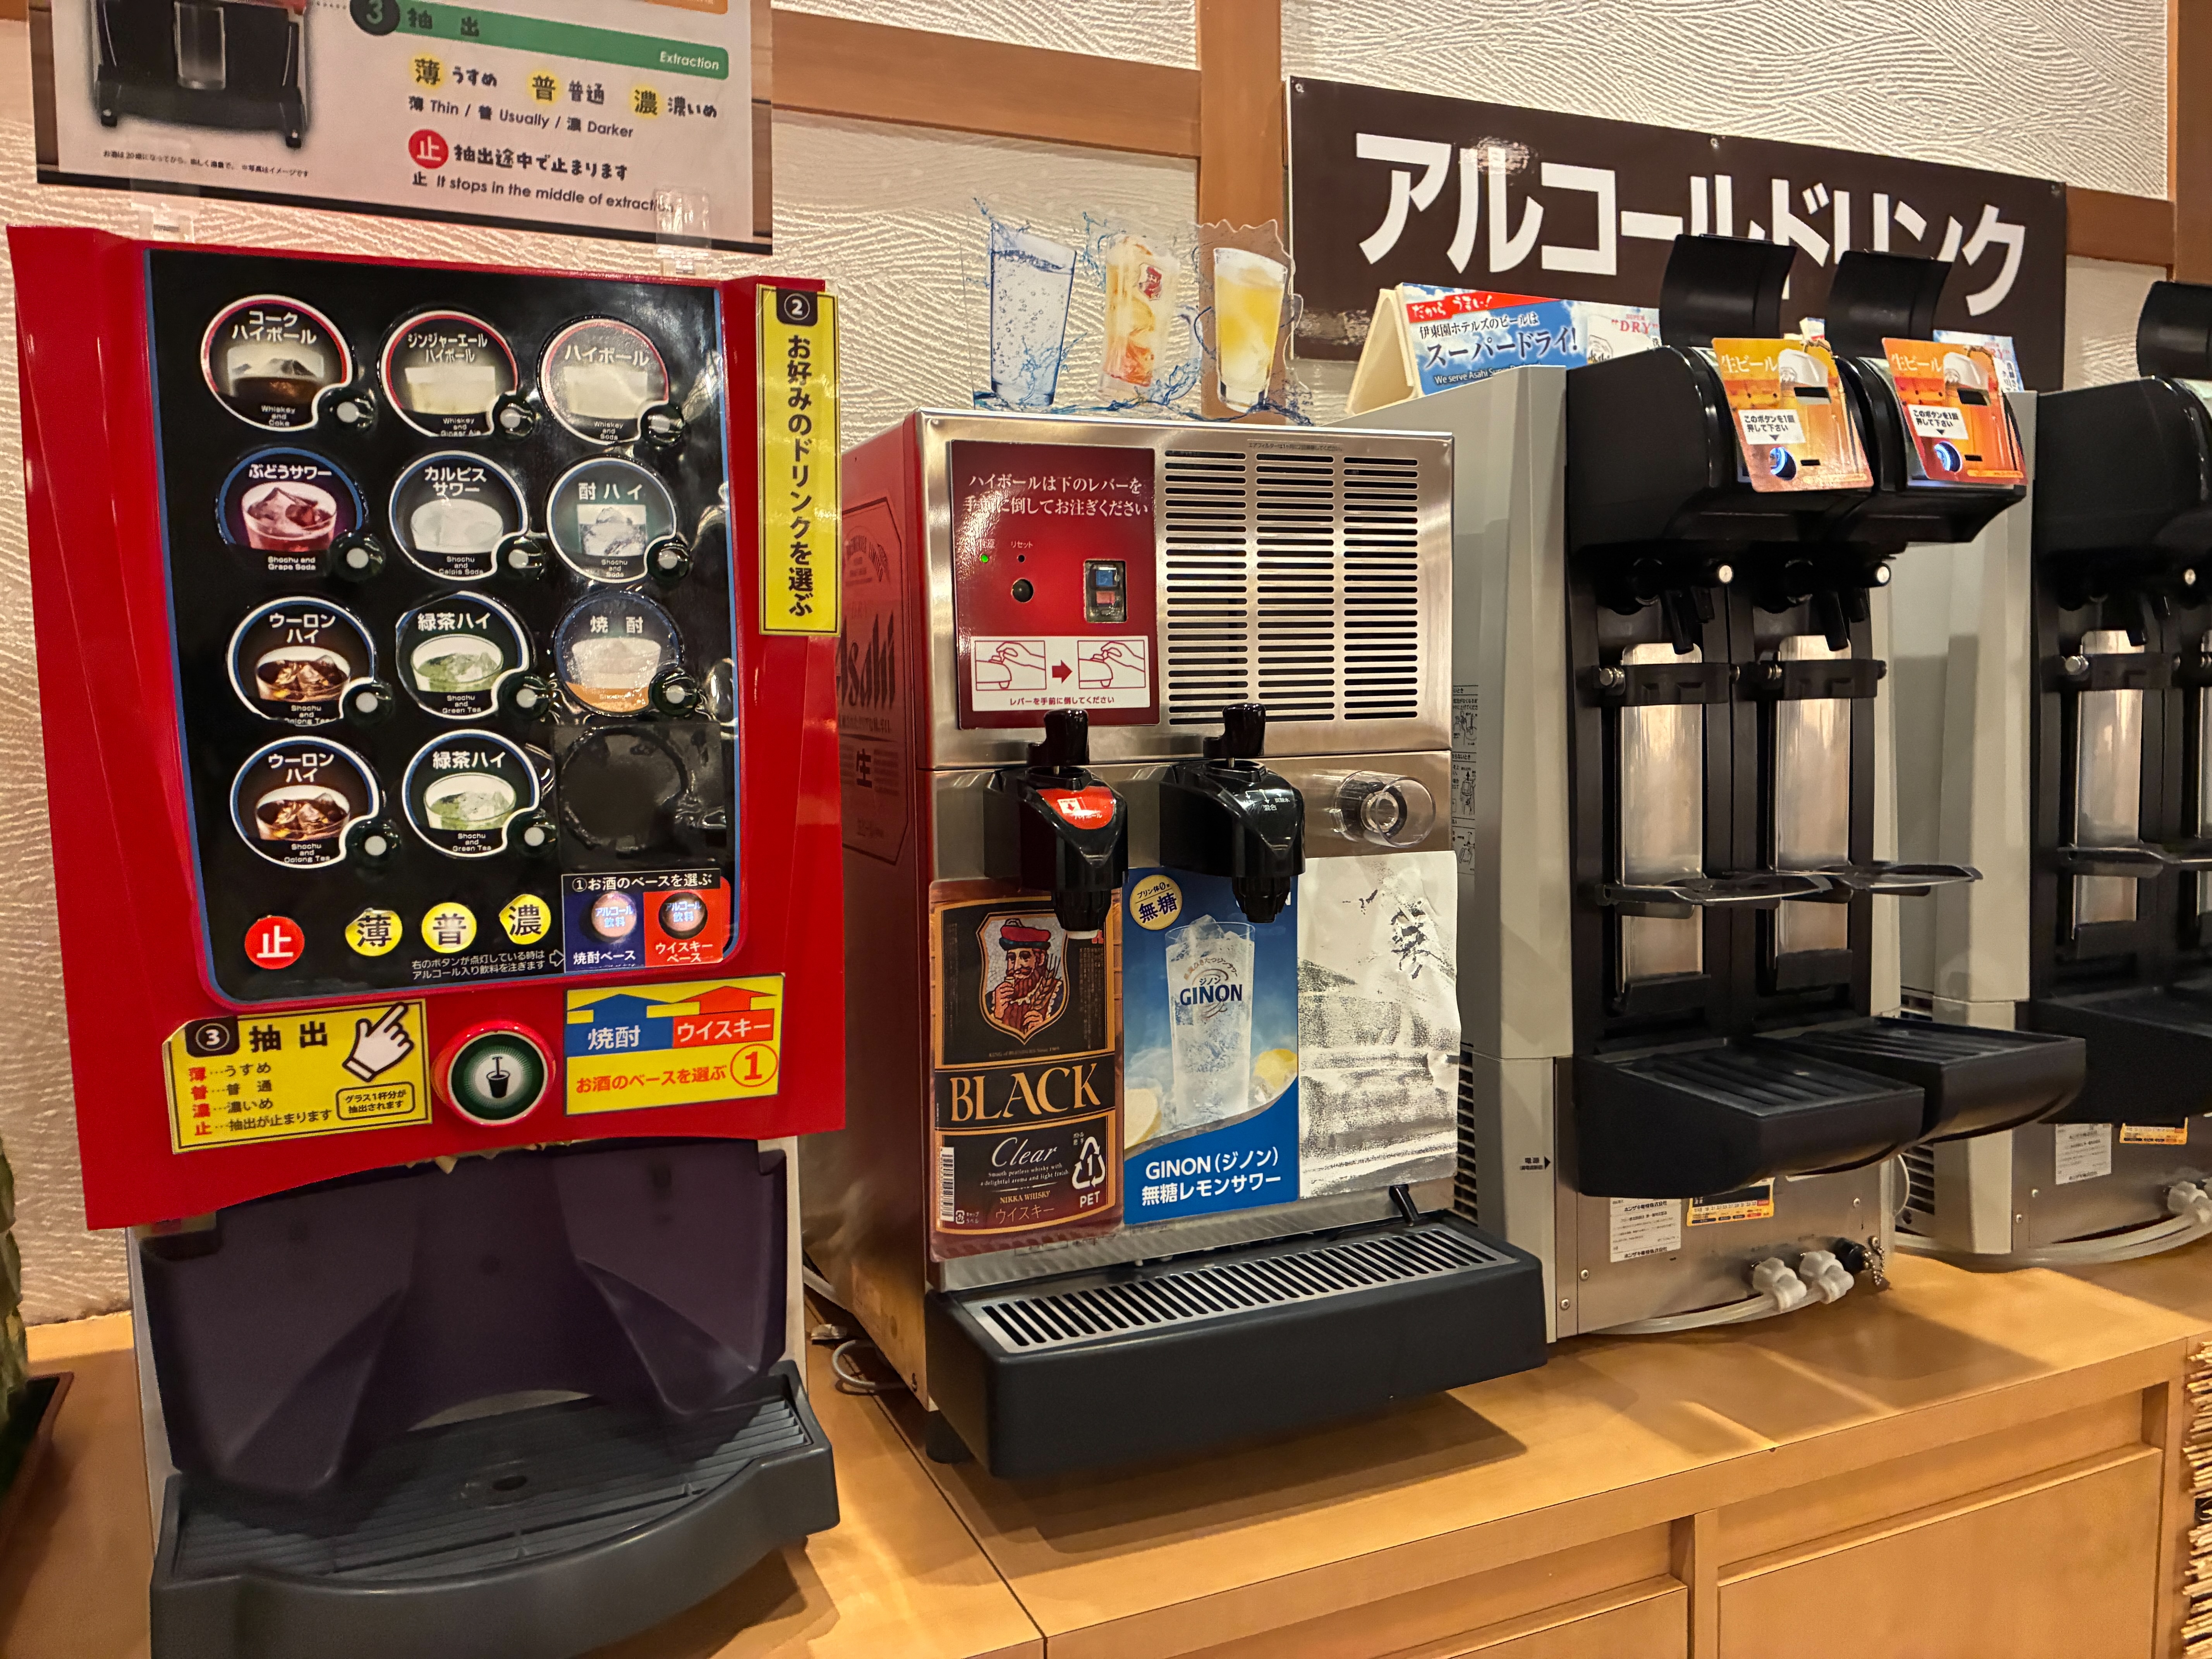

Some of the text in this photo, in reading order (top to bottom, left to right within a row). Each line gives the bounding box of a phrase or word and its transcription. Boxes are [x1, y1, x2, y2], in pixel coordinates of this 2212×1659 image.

[660, 51, 719, 70] Extraction
[452, 67, 497, 86] うすめ
[568, 81, 605, 104] 普通
[668, 97, 717, 118] 濃いめ
[431, 99, 459, 115] Thin
[500, 110, 549, 129] Usually
[588, 121, 633, 137] Darker
[454, 144, 627, 180] 抽出途中で止まります
[437, 175, 445, 187] It
[450, 177, 487, 194] stops
[492, 182, 504, 194] in
[510, 184, 531, 198] the
[537, 187, 584, 203] middle
[590, 192, 603, 205] of
[249, 311, 297, 327] コーク
[1420, 312, 1540, 341] 伊東園ホテルズのビールは
[232, 325, 317, 344] ハイボール
[408, 333, 488, 348] ジンジャーエール
[426, 349, 475, 363] ハイボール
[565, 345, 649, 366] ハイボール
[1427, 327, 1578, 368] スーパードライ!
[1721, 354, 1780, 374] 生ビール
[1891, 353, 1944, 373] 生ビール
[1435, 369, 1488, 384] We serve Asahi
[1747, 424, 1788, 433] 押して下さい
[1916, 417, 1953, 427] 押して下さい
[249, 464, 332, 480] ぶどうサワー
[424, 467, 487, 483] カルピス
[787, 335, 813, 617] お好みのドリンクを選ぶ
[433, 482, 480, 496] サワー
[579, 482, 642, 501] 酎ハイ
[969, 473, 1142, 495] ハイボールは下のレバーを
[269, 613, 336, 628] ウーロン
[417, 612, 491, 631] 緑茶ハイ
[287, 629, 319, 644] ハイ
[1010, 696, 1115, 706] レバーを手前に倒してください
[268, 753, 334, 768] ウーロン
[433, 751, 506, 770] 緑茶ハイ
[286, 768, 318, 783] ハイ
[595, 905, 634, 917] アルコール
[665, 901, 702, 912] アルコール
[1139, 892, 1178, 924] 無糖
[508, 903, 542, 936] 濃
[604, 916, 625, 928] 飲料
[673, 911, 694, 922] 飲料
[356, 912, 392, 948] 薄
[432, 913, 467, 946] 普
[257, 926, 294, 958] 止
[655, 942, 713, 955] ウイスキー
[573, 950, 636, 965] 焼酎ベース
[667, 953, 702, 963] ベース
[1199, 977, 1221, 986] ジノン
[1180, 984, 1243, 1006] GINON
[588, 1025, 641, 1051] 焼酎
[677, 1017, 771, 1042] ウイスキー
[576, 1065, 727, 1094] お酒のベースを選ぶ
[950, 1063, 1101, 1122] BLACK
[991, 1137, 1058, 1167] Clear
[1000, 1190, 1050, 1204] NIKKA WHISKY
[1142, 1173, 1281, 1206] 無糖レモンサワー
[1080, 1191, 1100, 1208] PET
[996, 1204, 1055, 1224] ウイスキー
